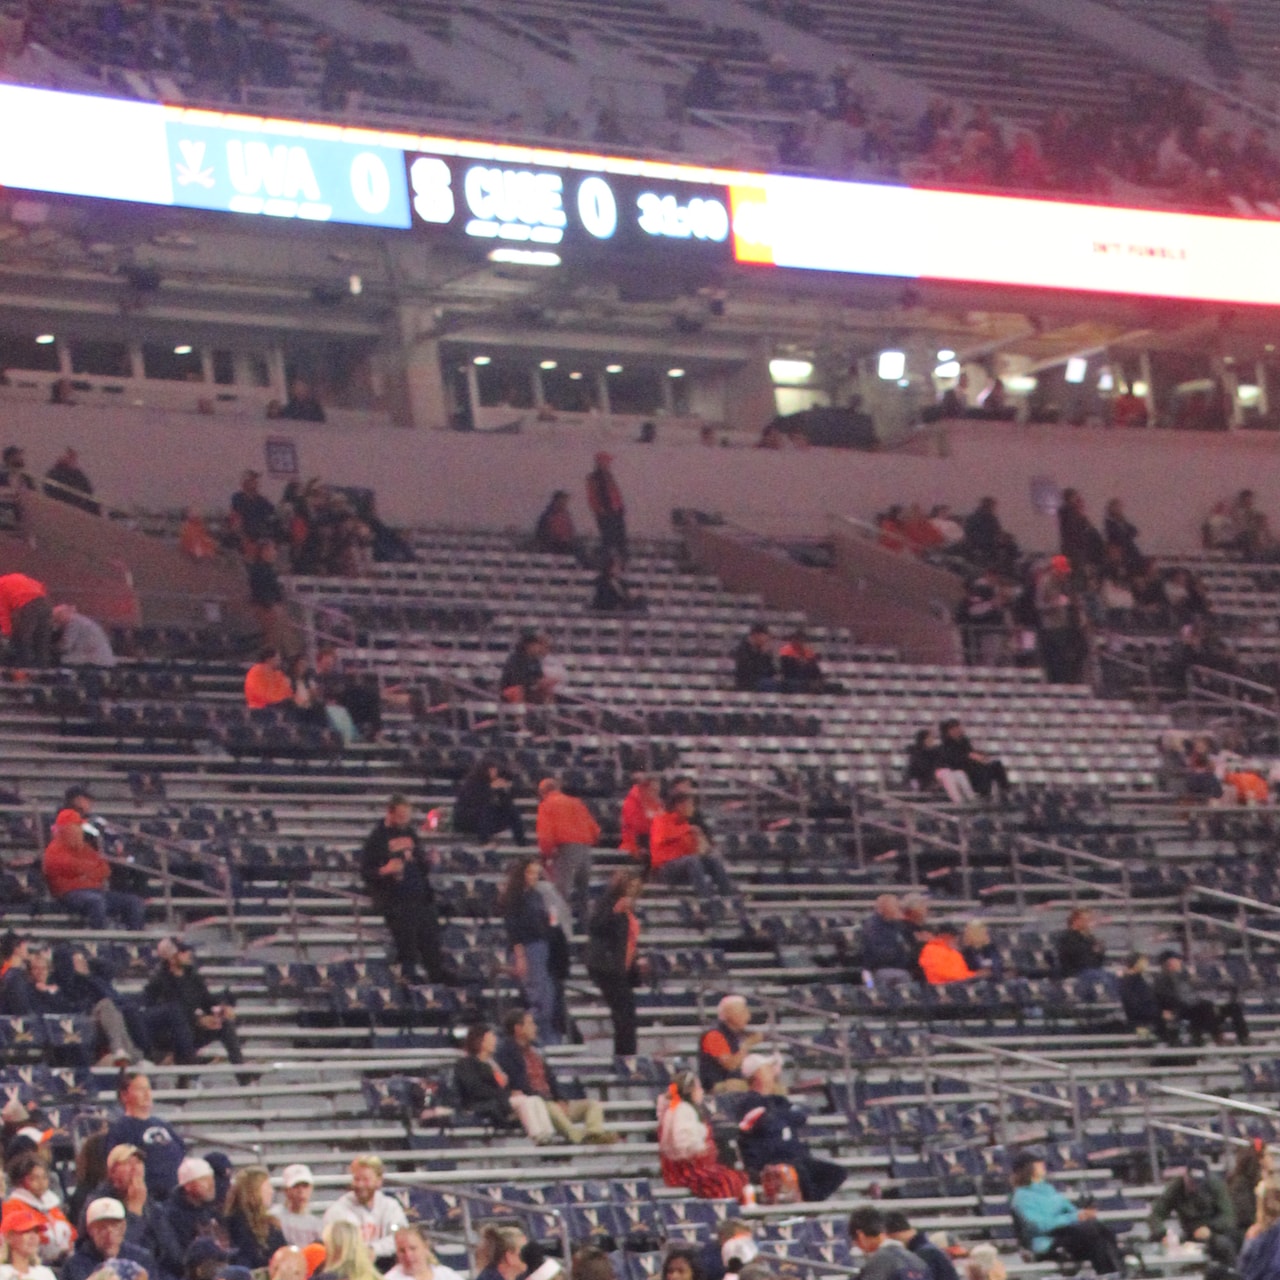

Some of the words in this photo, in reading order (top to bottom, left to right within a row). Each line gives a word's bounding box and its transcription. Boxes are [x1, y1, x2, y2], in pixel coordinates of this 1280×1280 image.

[226, 139, 321, 200] UVA
[351, 152, 390, 214] 0
[578, 176, 617, 239] 0
